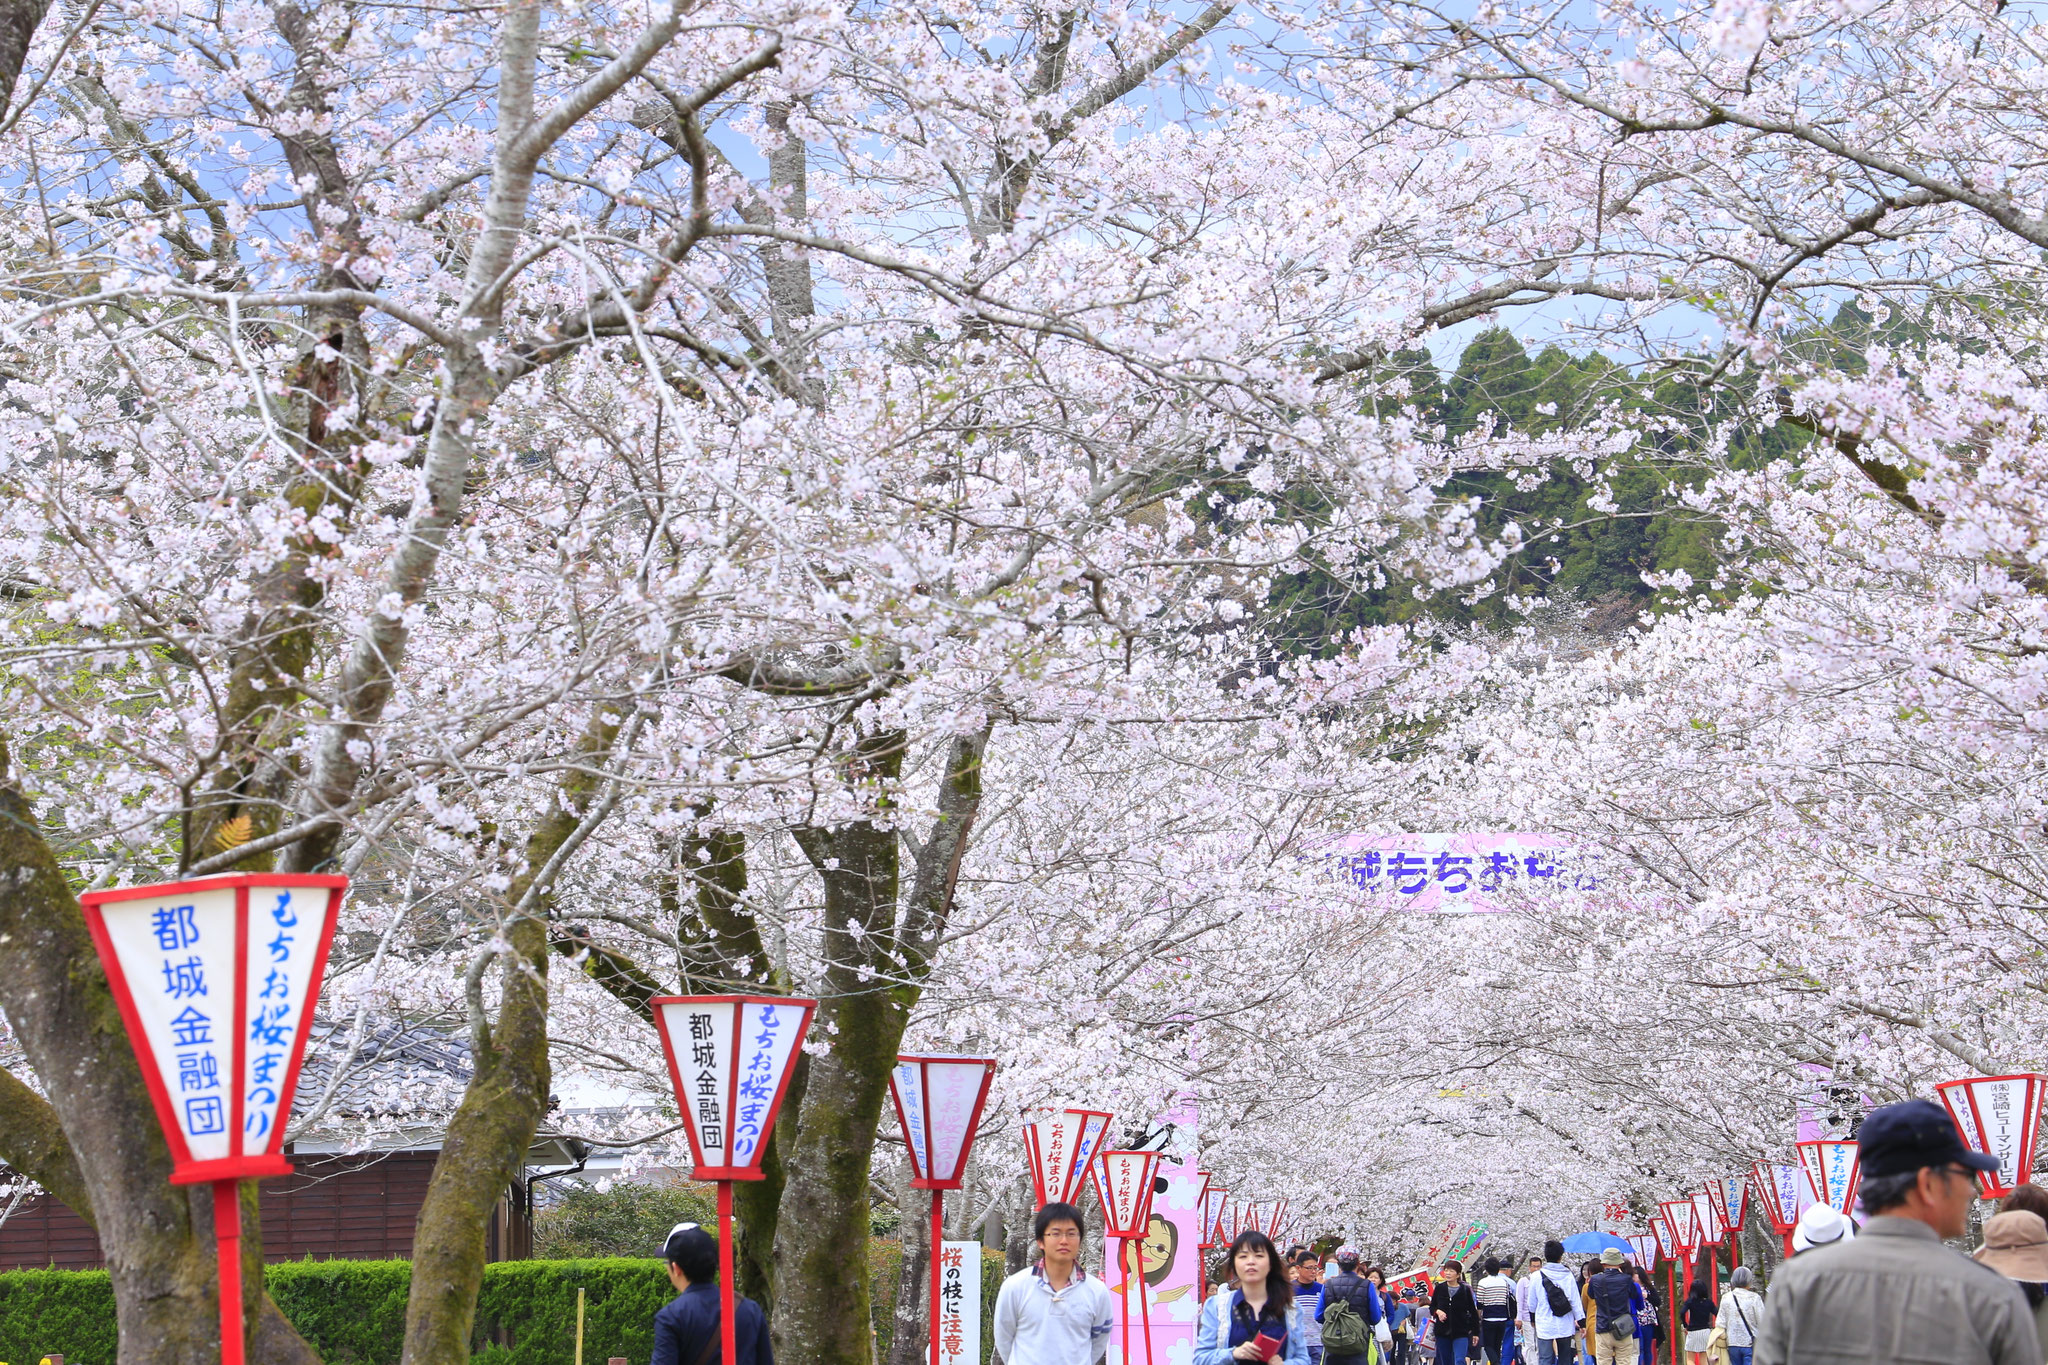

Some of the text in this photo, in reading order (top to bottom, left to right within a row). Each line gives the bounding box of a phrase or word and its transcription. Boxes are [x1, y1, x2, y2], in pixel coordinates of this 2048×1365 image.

[152, 905, 225, 1136] 都城金融団
[245, 889, 297, 1139] もちお桜まつり
[688, 1012, 723, 1150] 都城金融団
[735, 1004, 780, 1156] もちお桜まつり
[935, 1065, 964, 1174] もちお桜まつり
[1118, 1157, 1131, 1224] もちお桜まつり
[1728, 1179, 1740, 1225] もちお桜まつり
[1780, 1165, 1796, 1222] もちお桜まつり
[1829, 1144, 1847, 1211] もちお桜まつり
